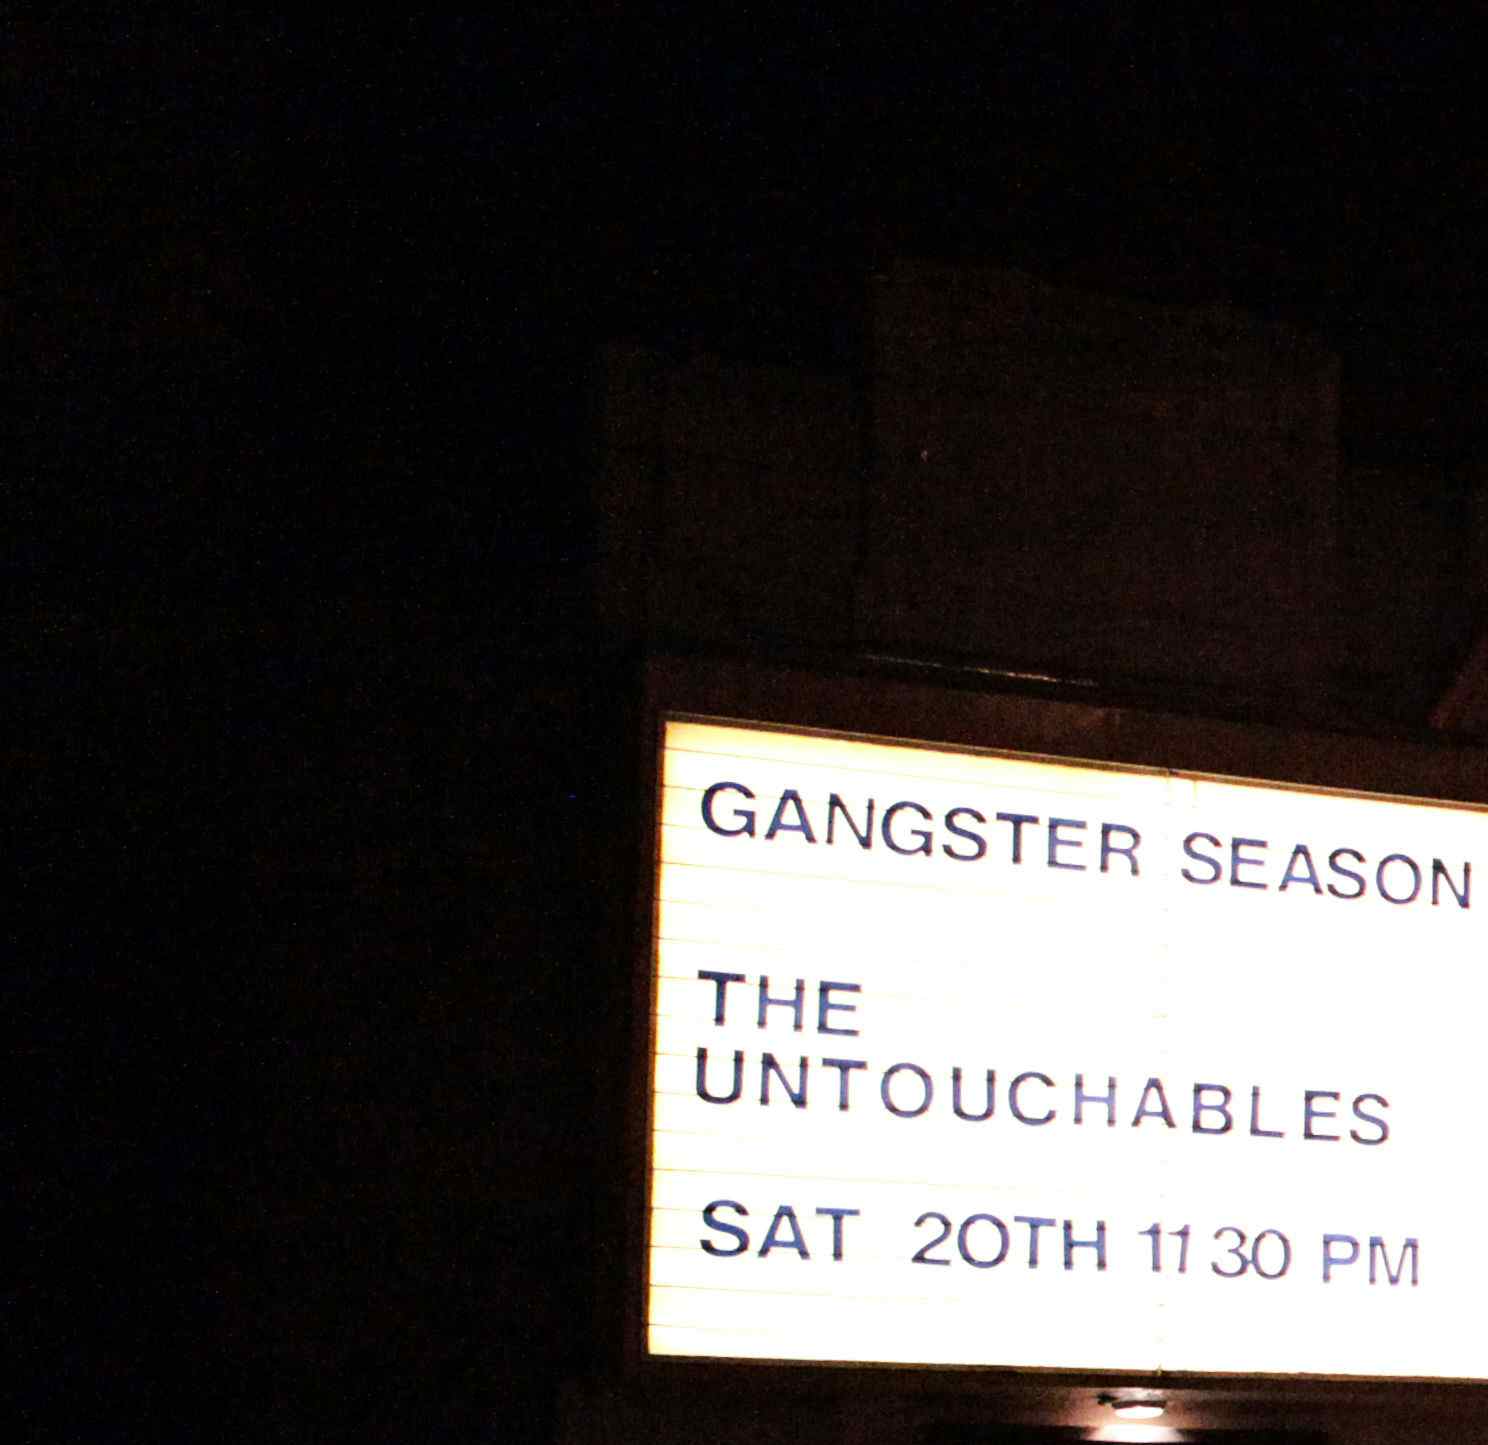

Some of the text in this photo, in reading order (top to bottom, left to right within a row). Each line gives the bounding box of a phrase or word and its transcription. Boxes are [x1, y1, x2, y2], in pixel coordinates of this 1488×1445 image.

[700, 780, 1472, 911] GANGSTER SEASON
[697, 969, 862, 1038] THE
[694, 1046, 1390, 1146] UNTOUCHABLES
[699, 1199, 861, 1262] SAT
[910, 1211, 1108, 1272] 20TH
[1322, 1233, 1420, 1287] PM
